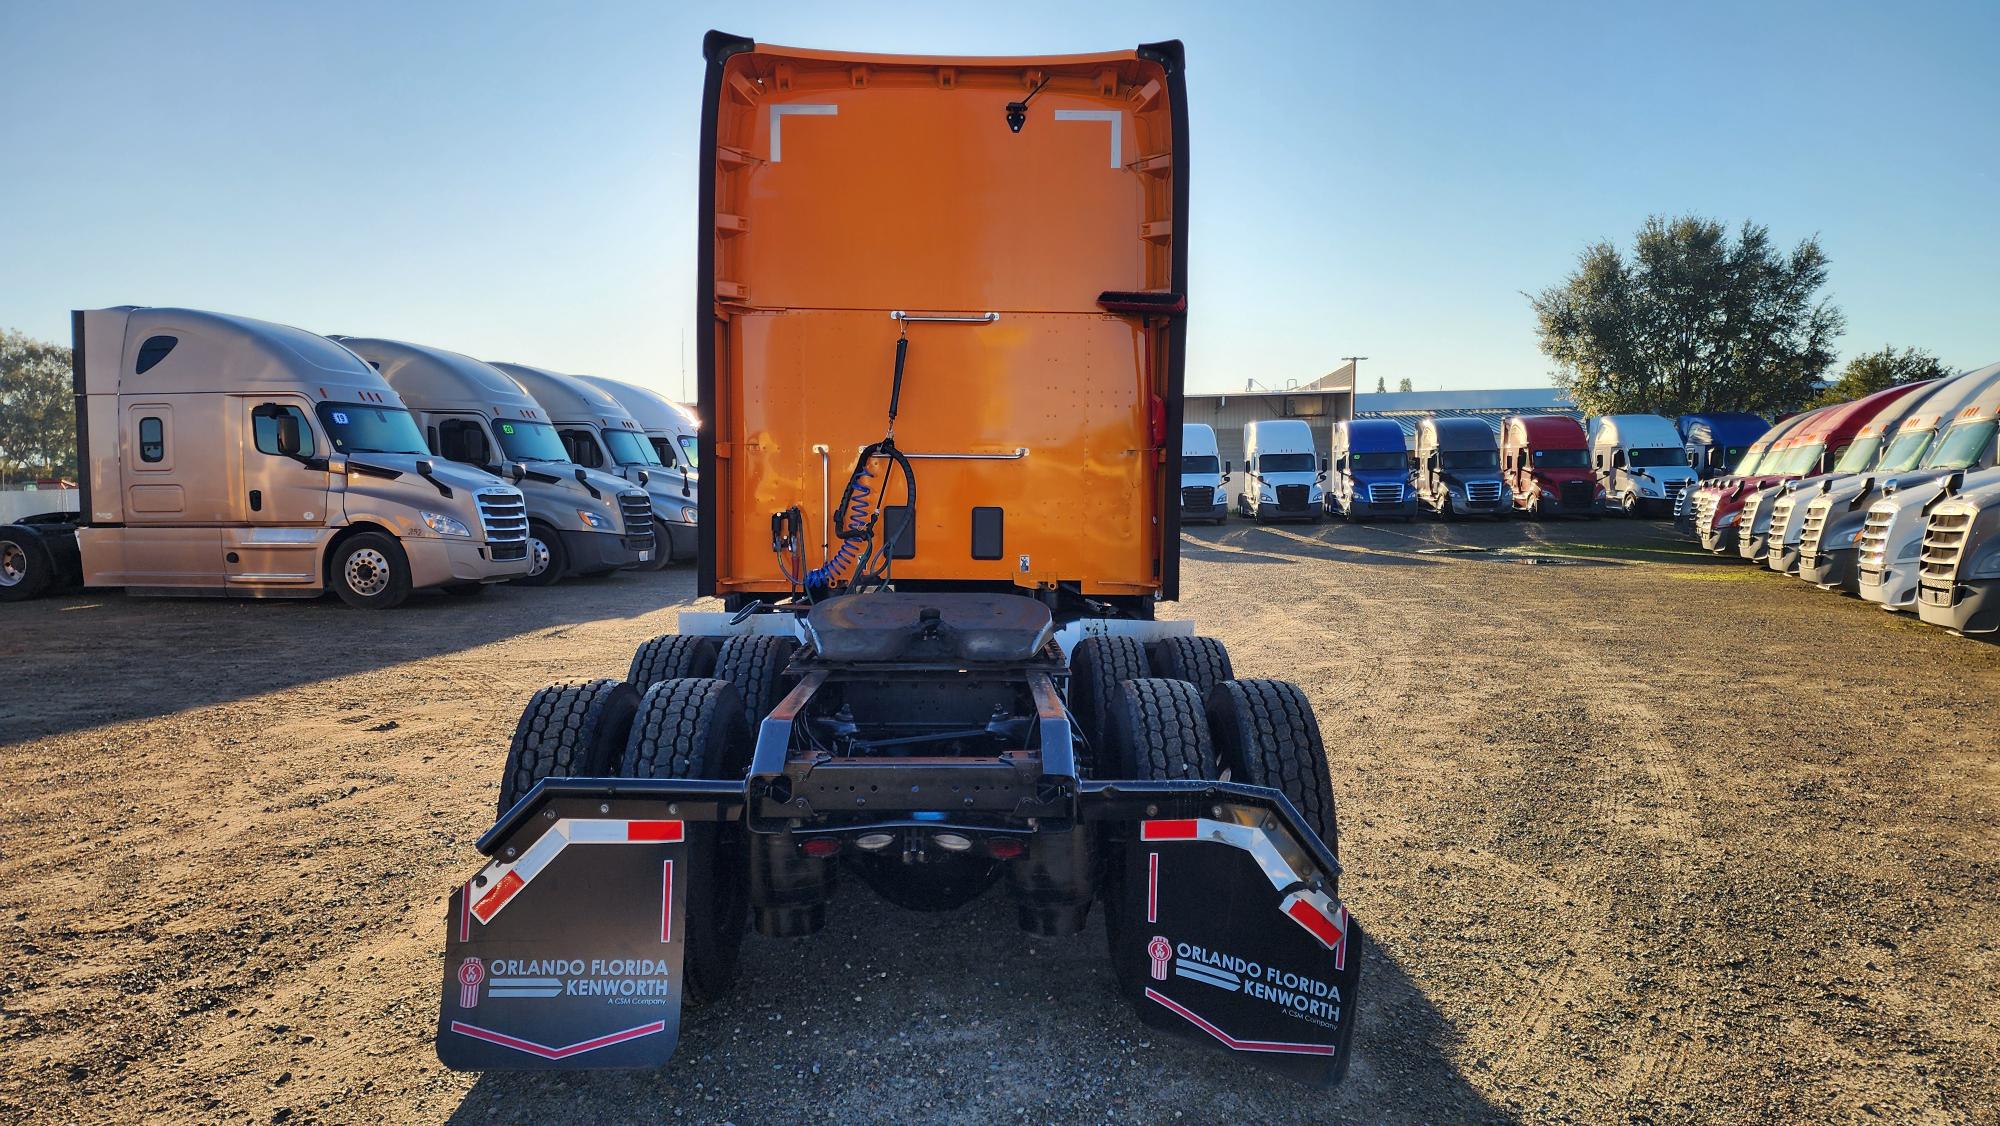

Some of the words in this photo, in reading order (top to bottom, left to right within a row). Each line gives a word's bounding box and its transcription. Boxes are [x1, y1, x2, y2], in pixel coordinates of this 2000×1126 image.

[490, 959, 585, 976] ORLANDO
[591, 959, 669, 976] FLORIDA
[1176, 942, 1262, 978] ORLANDO
[1266, 968, 1341, 1003] FLORIDA
[566, 979, 668, 996] KENWORTH
[632, 998, 666, 1007] Company
[1244, 979, 1340, 1022] KENWORTH
[1288, 1010, 1304, 1020] CSM
[1304, 1015, 1338, 1031] Company
